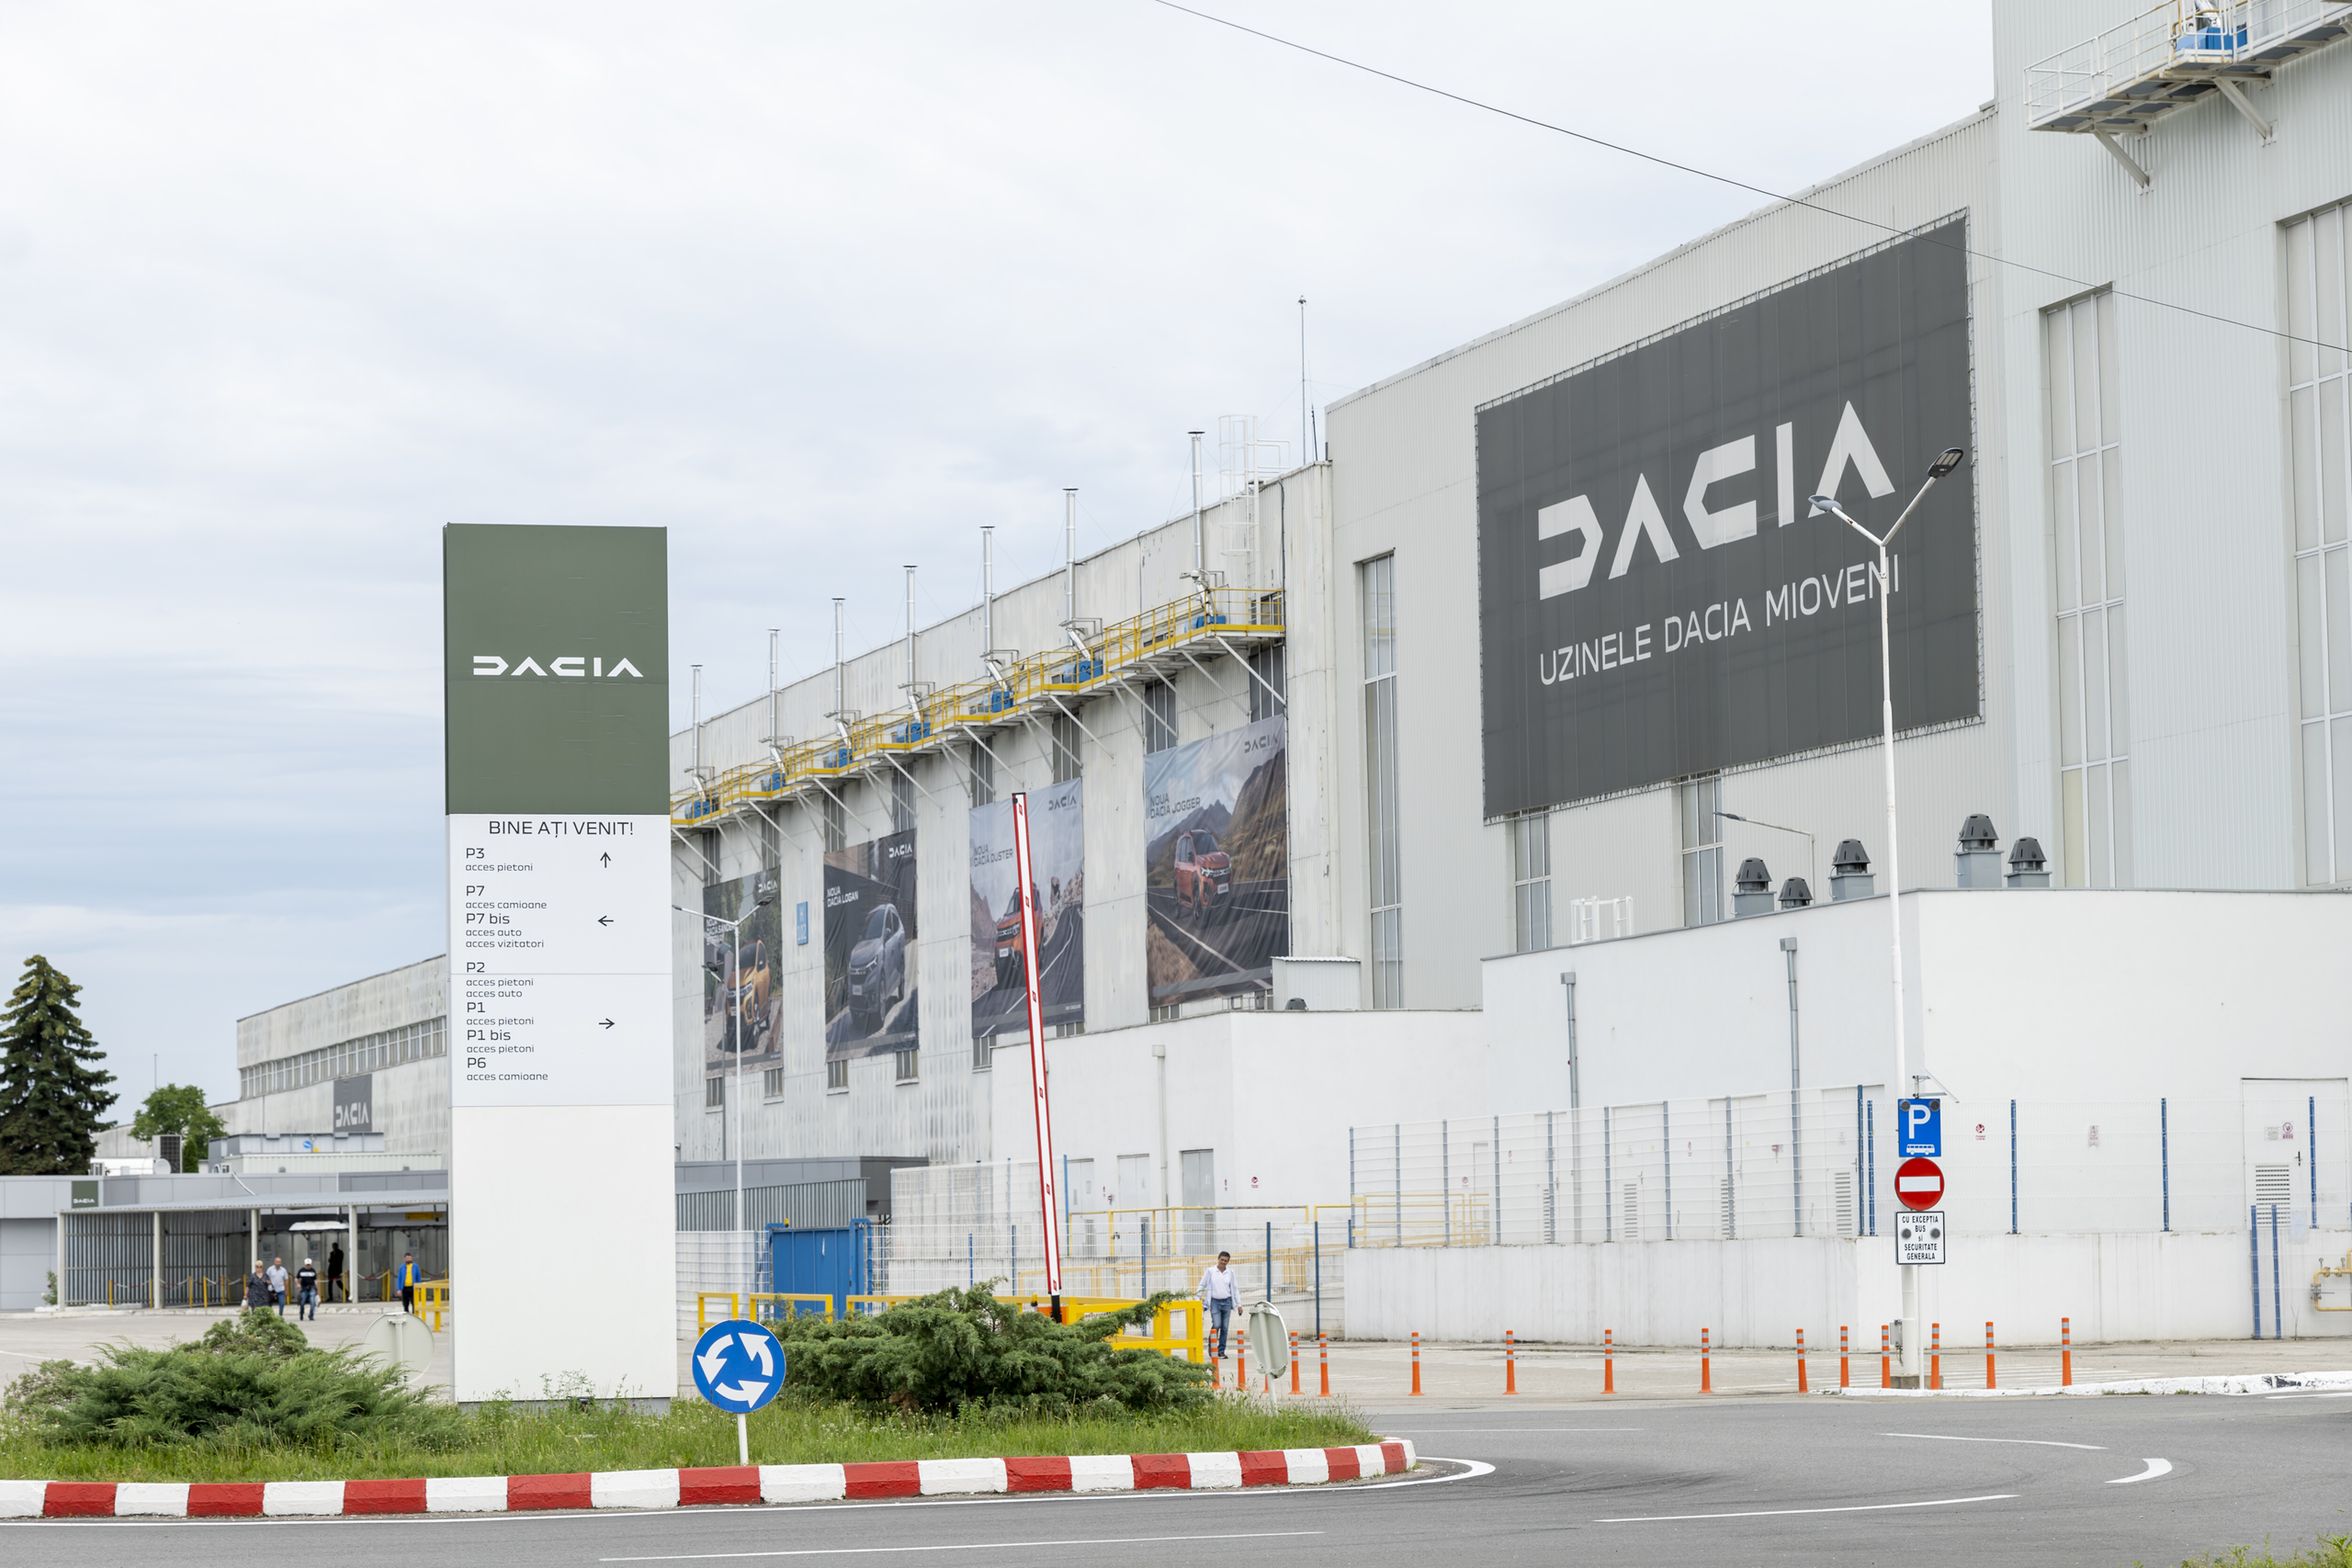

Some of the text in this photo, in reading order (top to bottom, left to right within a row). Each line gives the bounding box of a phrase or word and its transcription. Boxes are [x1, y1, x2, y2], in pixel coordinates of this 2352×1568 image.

[1538, 400, 1895, 601] DACIA
[1540, 554, 1899, 685] UZINELE DACIA MIOVENI
[473, 656, 644, 677] DACIA
[1244, 734, 1278, 753] DACIA
[1049, 795, 1077, 811] DACIA
[1150, 793, 1169, 806] NOUA
[1151, 797, 1200, 819] DACIA JOGGER
[489, 821, 634, 839] BINE AȚI VENIT!
[466, 847, 485, 859] P3
[889, 843, 913, 859] DACIA
[974, 844, 988, 857] NOUA
[974, 848, 1014, 867] DACIA DUSTER
[498, 863, 533, 873] pietoni
[466, 885, 485, 896] P7
[758, 880, 778, 893] DACIA
[826, 886, 841, 898] NOUA
[498, 901, 547, 909] camioane
[827, 891, 859, 908] DACIA LOGAN
[466, 913, 510, 925] P7 bis
[498, 940, 544, 948] vizitatori
[466, 962, 485, 973] P2
[498, 978, 533, 988] pietoni
[467, 1002, 485, 1013] P1
[498, 1017, 534, 1027] pietoni
[467, 1029, 511, 1041] P1 bis
[498, 1045, 534, 1054] pietoni
[467, 1057, 486, 1069] P6
[499, 1072, 548, 1081] camioane
[336, 1102, 369, 1128] DACIA
[1908, 1104, 1931, 1139] P
